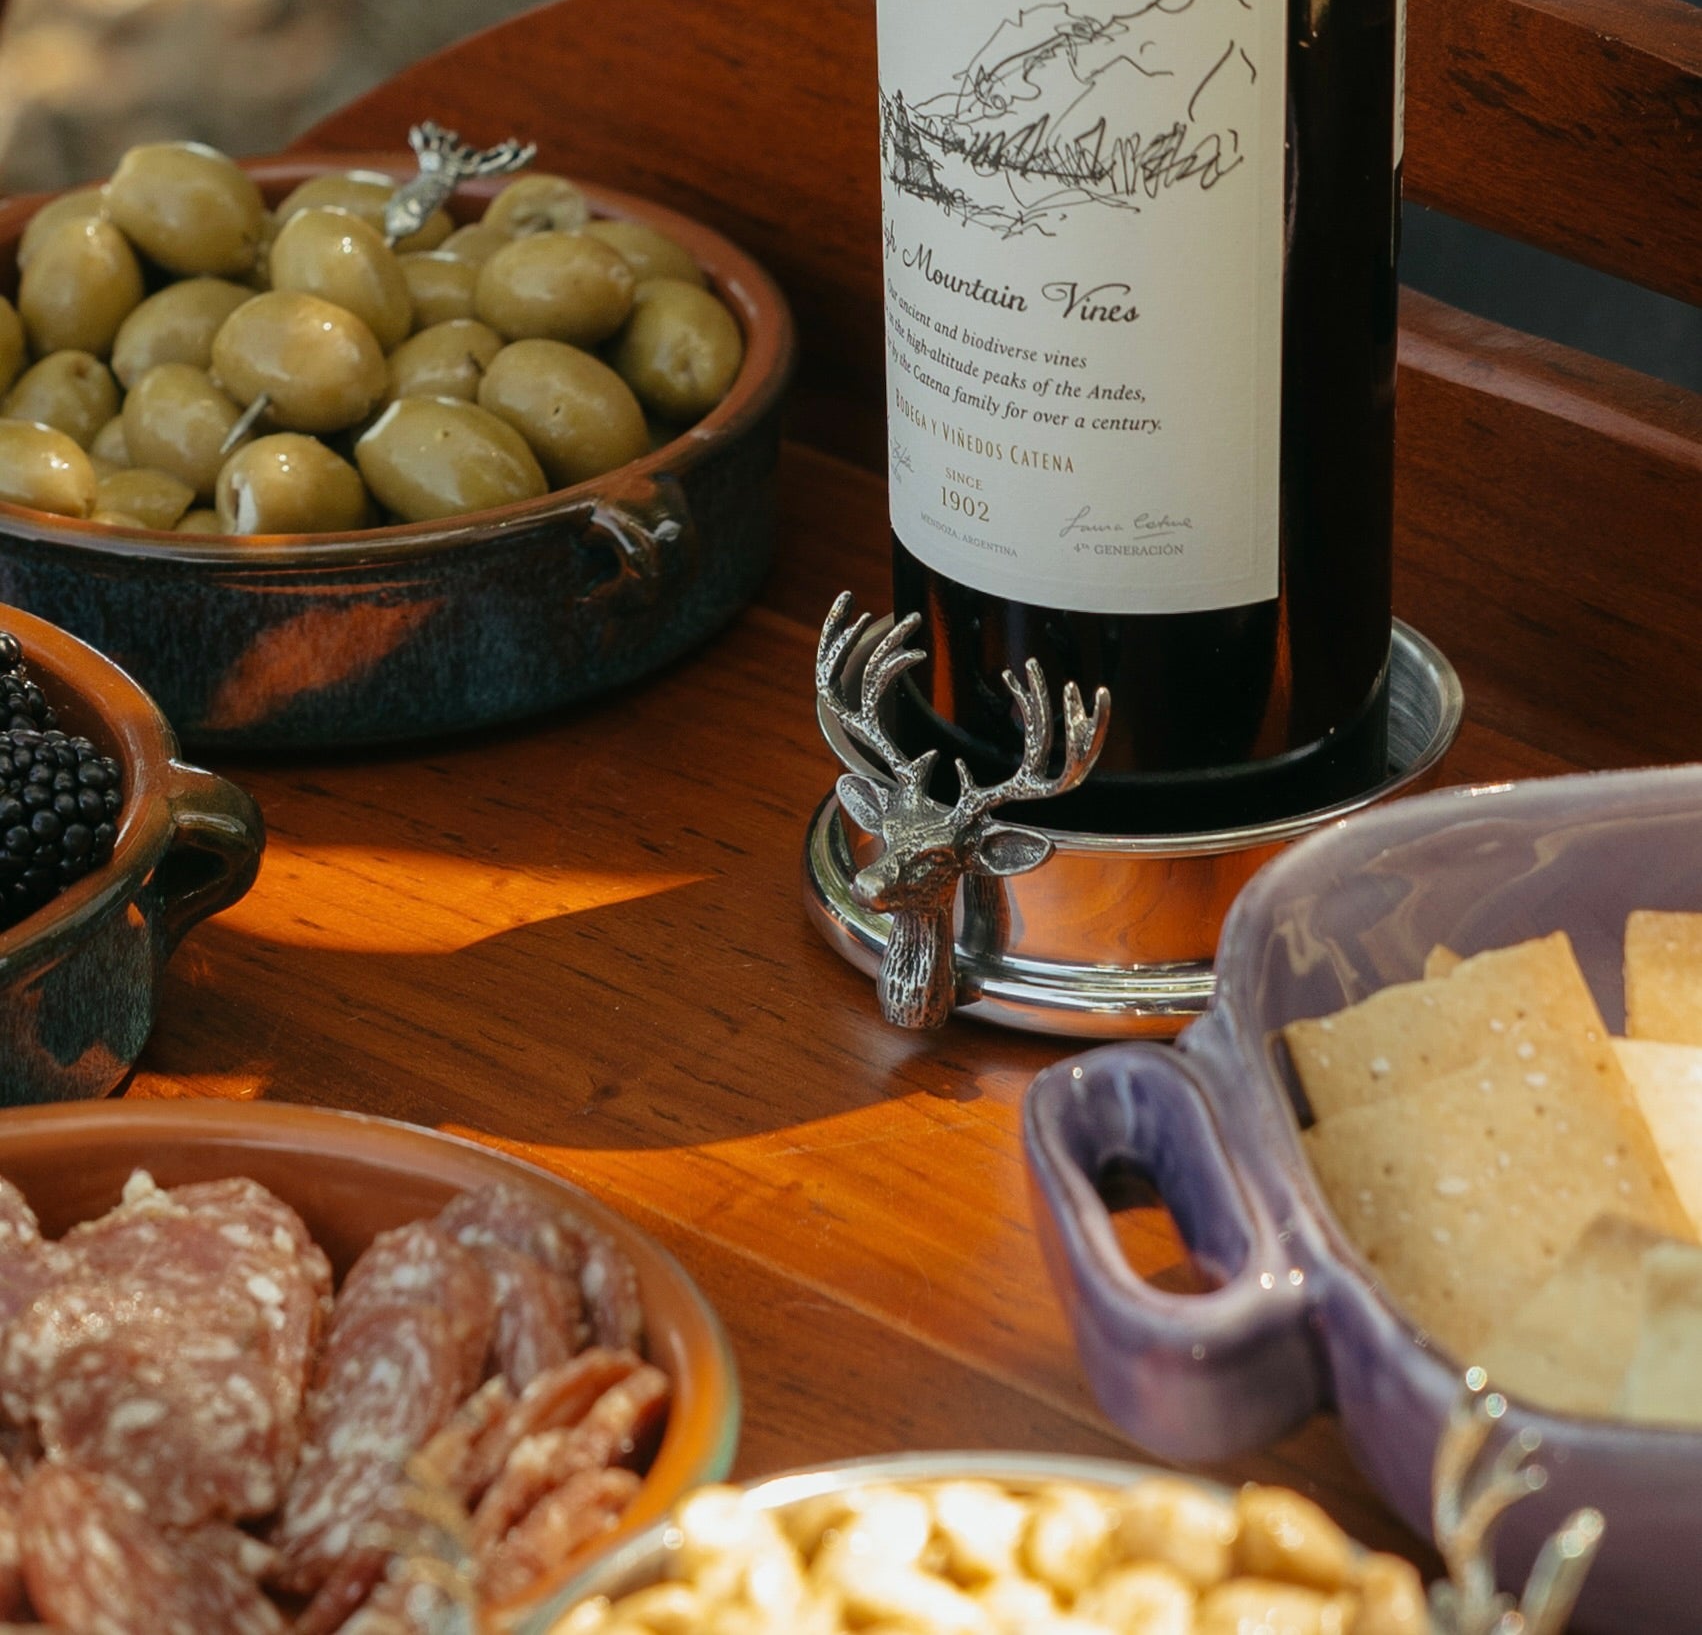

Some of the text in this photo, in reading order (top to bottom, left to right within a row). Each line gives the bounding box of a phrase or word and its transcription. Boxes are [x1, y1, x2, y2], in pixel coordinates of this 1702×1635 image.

[902, 243, 1028, 313] Mountain
[1041, 281, 1140, 323] Vines
[899, 295, 931, 328] ancient
[934, 319, 958, 341] and
[962, 325, 1038, 362] biodiverse
[1044, 350, 1088, 369] vines
[906, 328, 979, 378] high-altitude
[983, 368, 1027, 392] peaks
[1032, 377, 1055, 398] of
[1055, 380, 1082, 399] the
[1087, 383, 1147, 404] Andes,
[899, 350, 912, 374] the
[913, 365, 951, 397] Catena
[952, 386, 1001, 419] family
[1001, 401, 1029, 421] for
[1033, 408, 1069, 427] over
[1074, 416, 1085, 429] a
[1091, 416, 1162, 435] century.
[895, 388, 927, 431] BODEGA
[931, 419, 938, 437] Y
[942, 421, 1003, 461] VIÑEDOS
[1010, 445, 1075, 474] CATENA
[941, 486, 990, 522] 1902
[945, 467, 983, 491] SINCE
[962, 533, 1018, 558] ARGENTINA
[1094, 542, 1185, 556] GENERACIÓN
